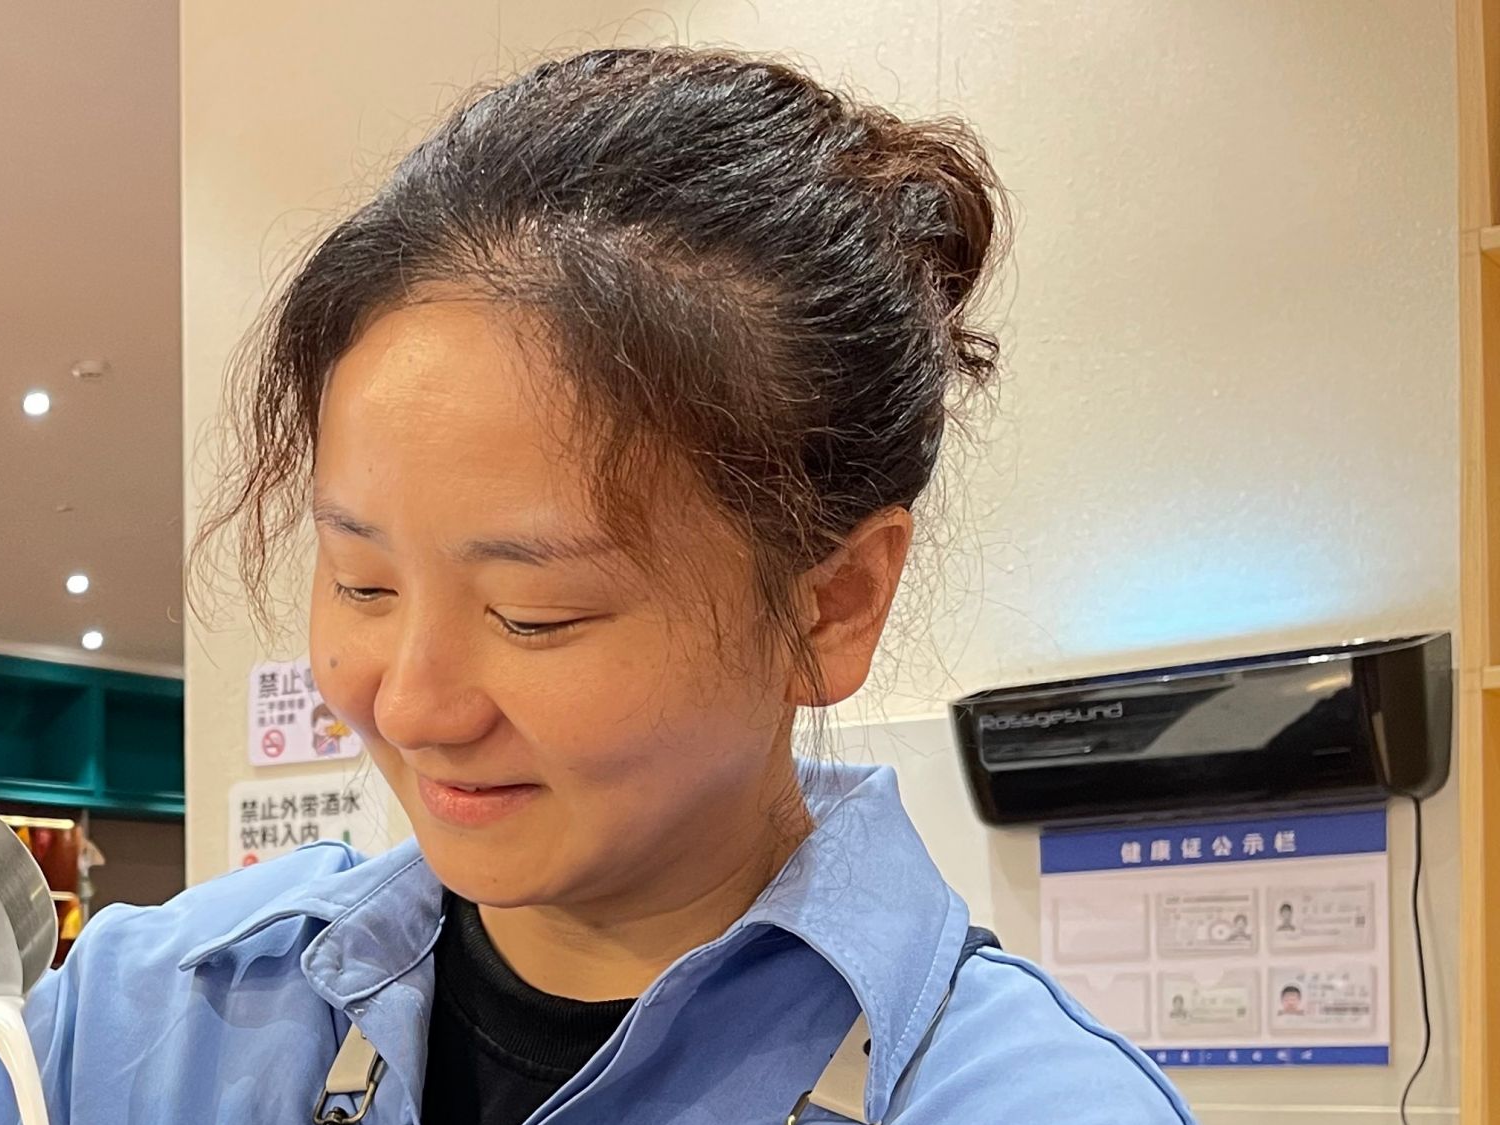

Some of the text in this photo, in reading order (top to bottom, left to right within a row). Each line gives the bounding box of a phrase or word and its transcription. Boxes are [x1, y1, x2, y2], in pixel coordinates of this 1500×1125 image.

[240, 793, 361, 824] 禁止外带酒水
[240, 824, 319, 850] 饮料入内
[1120, 829, 1297, 864] 健康证公示栏
